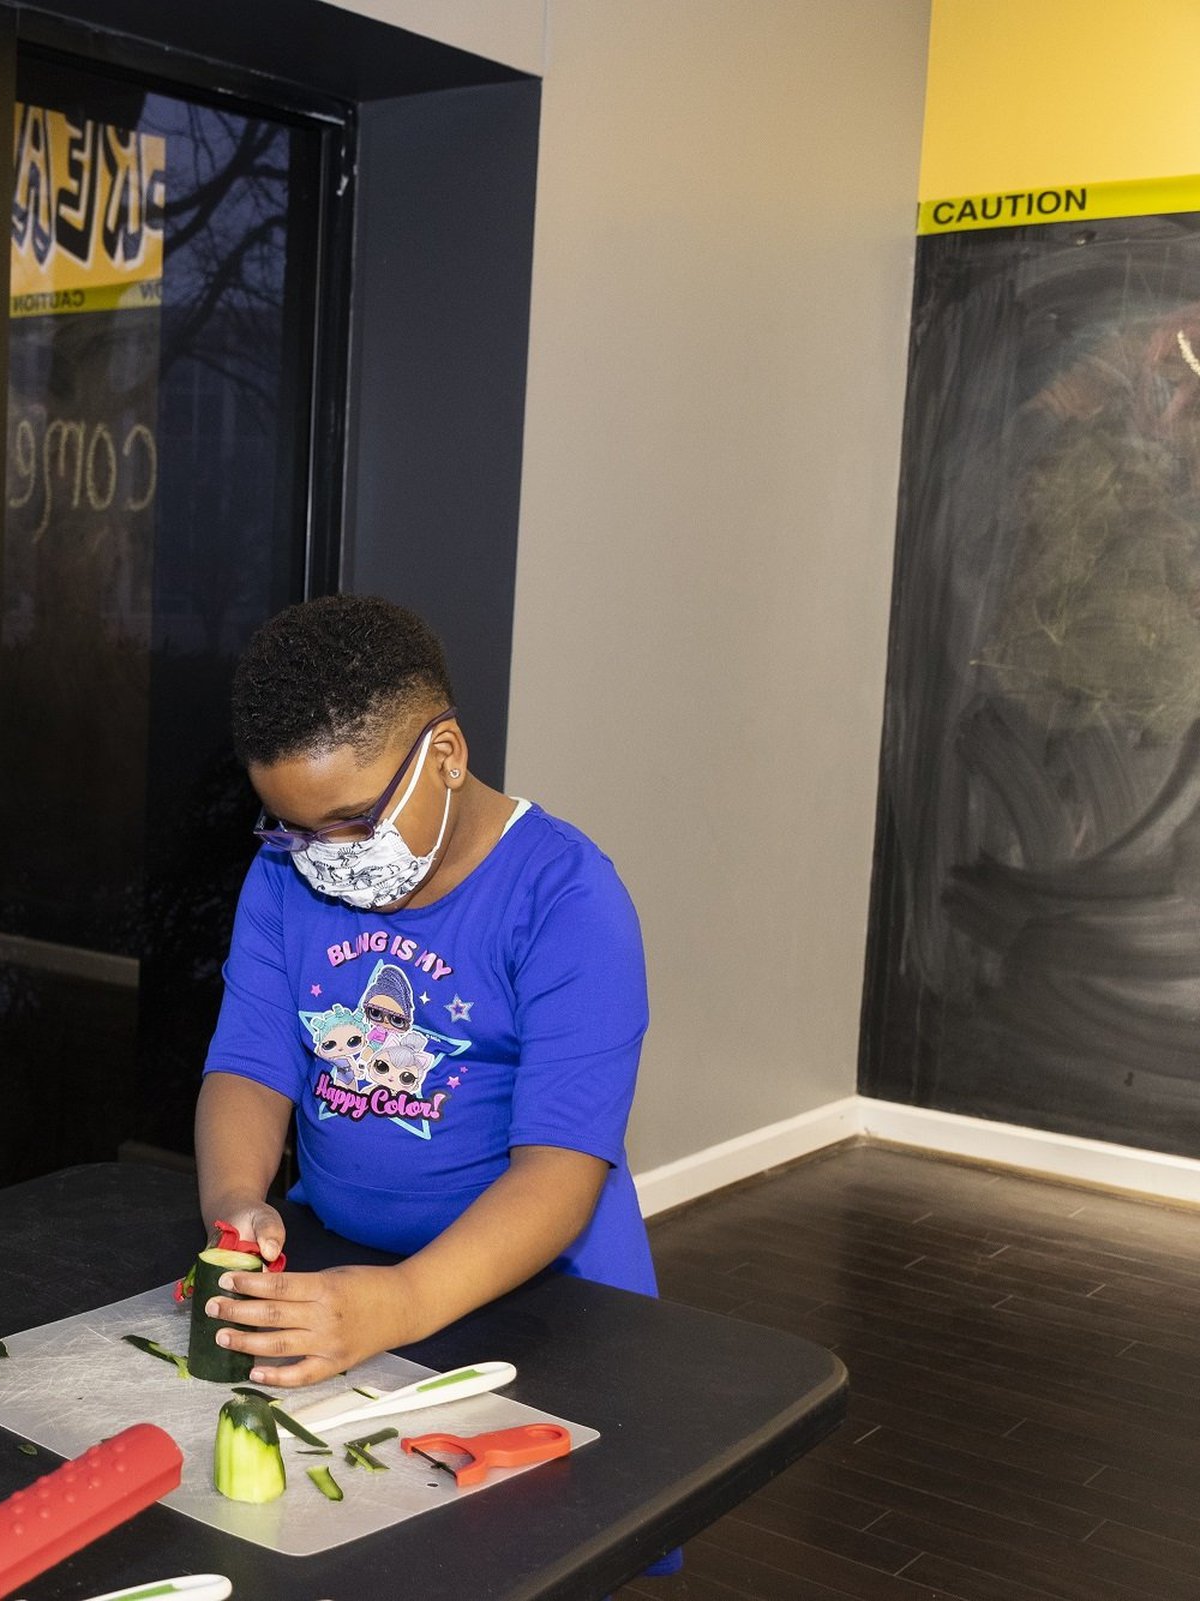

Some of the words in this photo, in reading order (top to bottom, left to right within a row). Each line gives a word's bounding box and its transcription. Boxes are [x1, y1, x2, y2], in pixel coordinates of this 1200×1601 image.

[932, 188, 1087, 225] CAUTION
[327, 931, 389, 967] BLING
[390, 935, 418, 961] IS
[414, 950, 453, 981] MY
[315, 1073, 369, 1119] Happy
[370, 1089, 446, 1119] Color!
